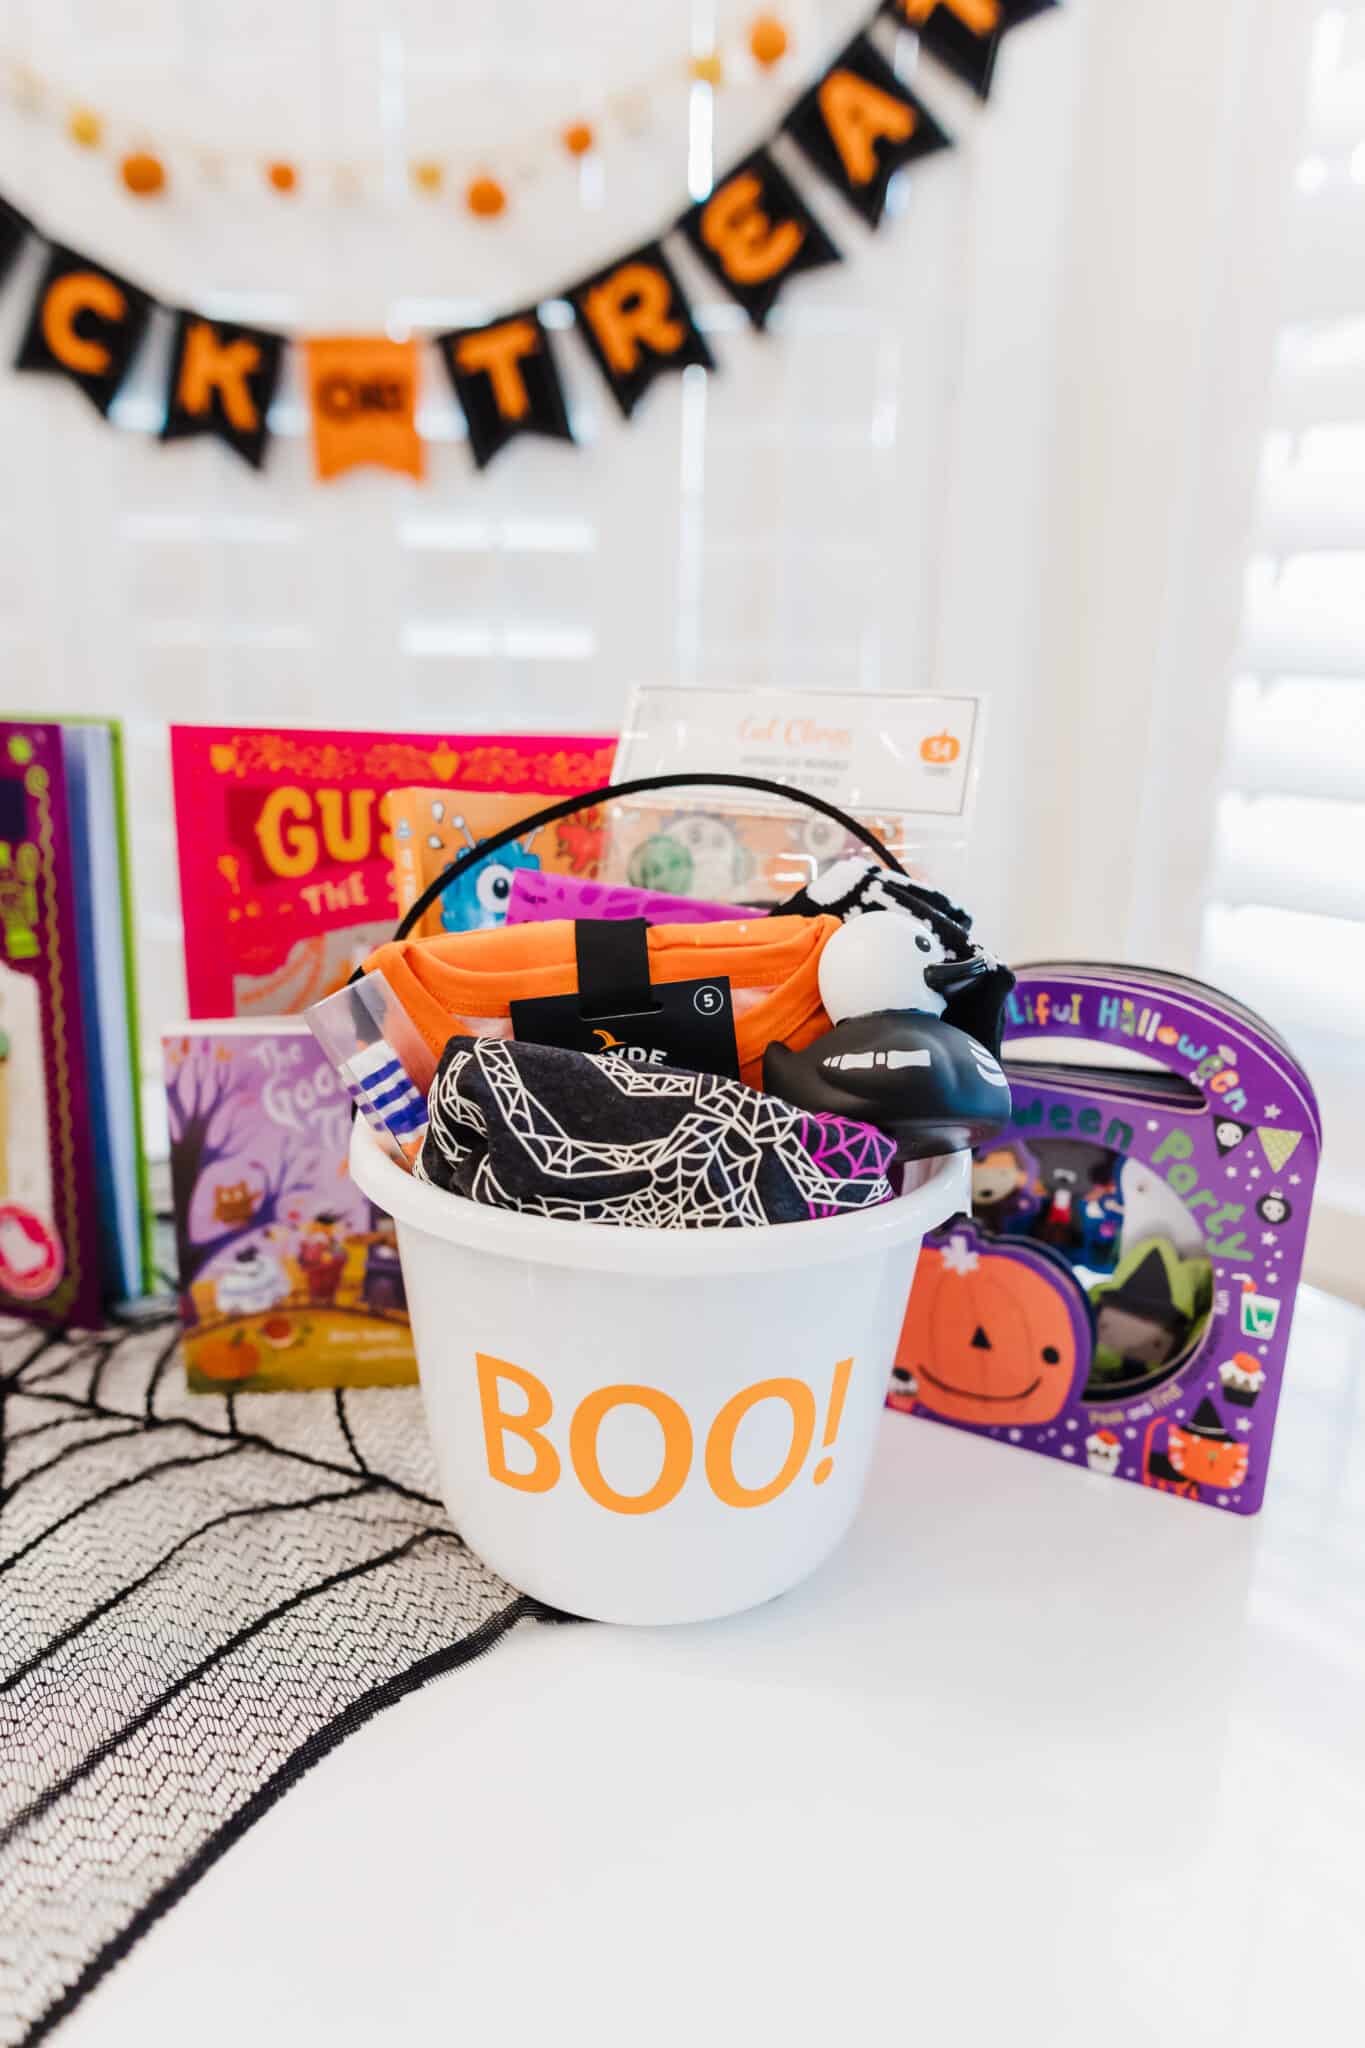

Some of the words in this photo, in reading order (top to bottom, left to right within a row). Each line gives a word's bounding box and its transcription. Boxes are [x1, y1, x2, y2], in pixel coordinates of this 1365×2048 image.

[301, 872, 368, 915] THE
[703, 993, 714, 1008] 5
[1098, 995, 1248, 1112] Halloween
[1150, 1128, 1257, 1261] Party
[475, 1352, 854, 1515] BOO!
